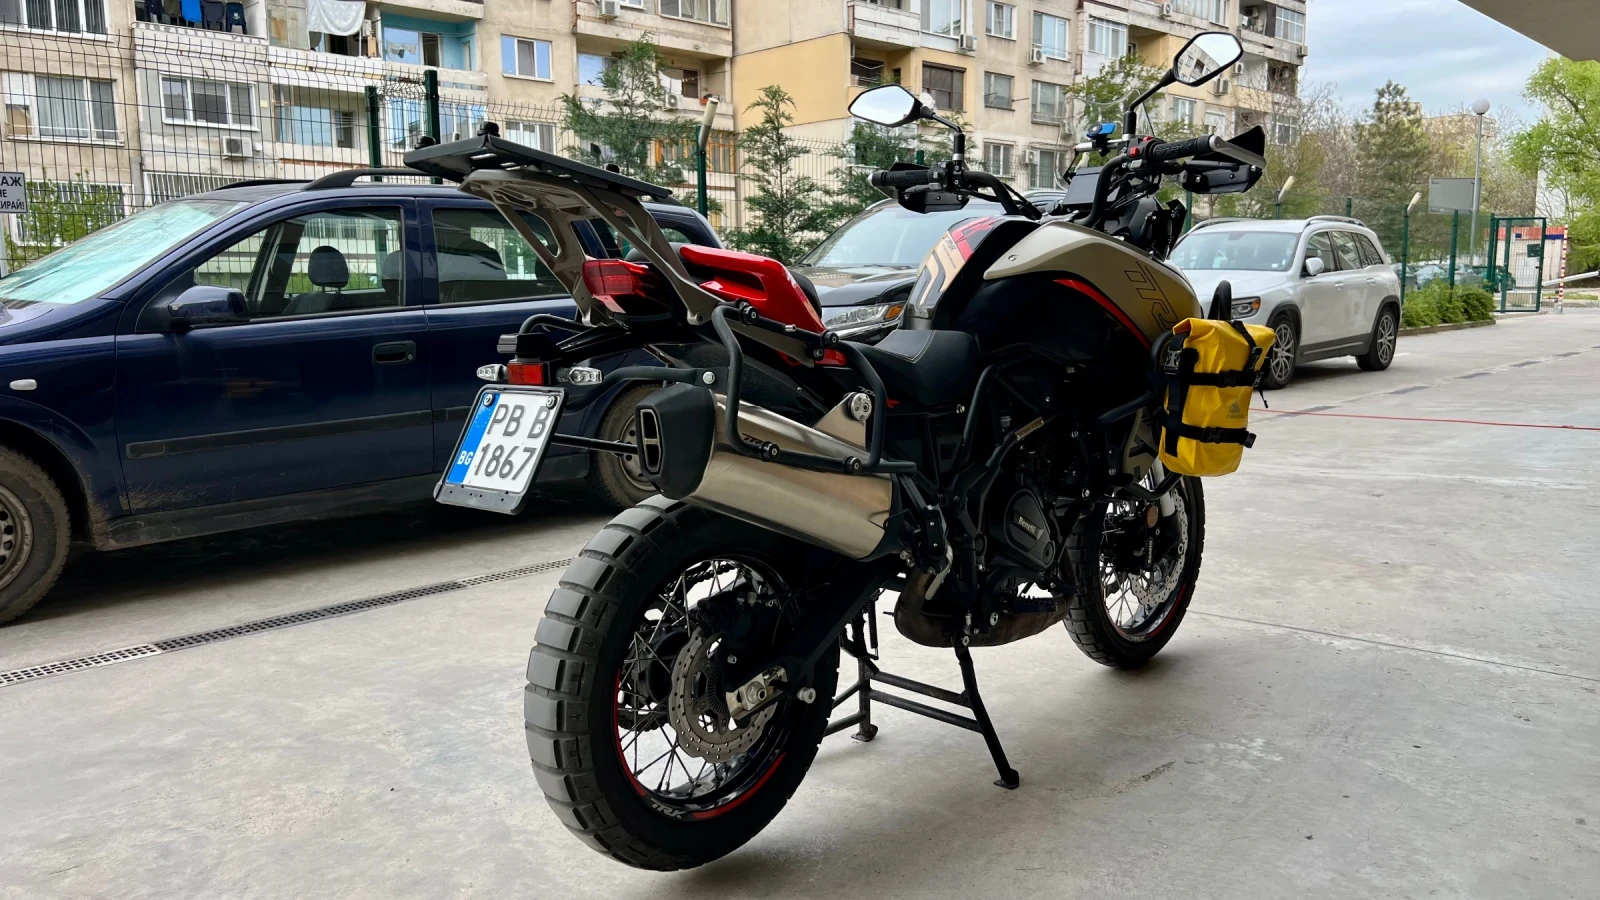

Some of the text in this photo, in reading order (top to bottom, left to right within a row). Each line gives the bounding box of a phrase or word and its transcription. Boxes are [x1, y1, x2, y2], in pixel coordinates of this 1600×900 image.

[0, 199, 25, 210] ИРАЙ!
[486, 404, 551, 439] PB B
[457, 450, 474, 466] BG
[473, 443, 537, 481] 1867
[650, 797, 687, 819] TRK
